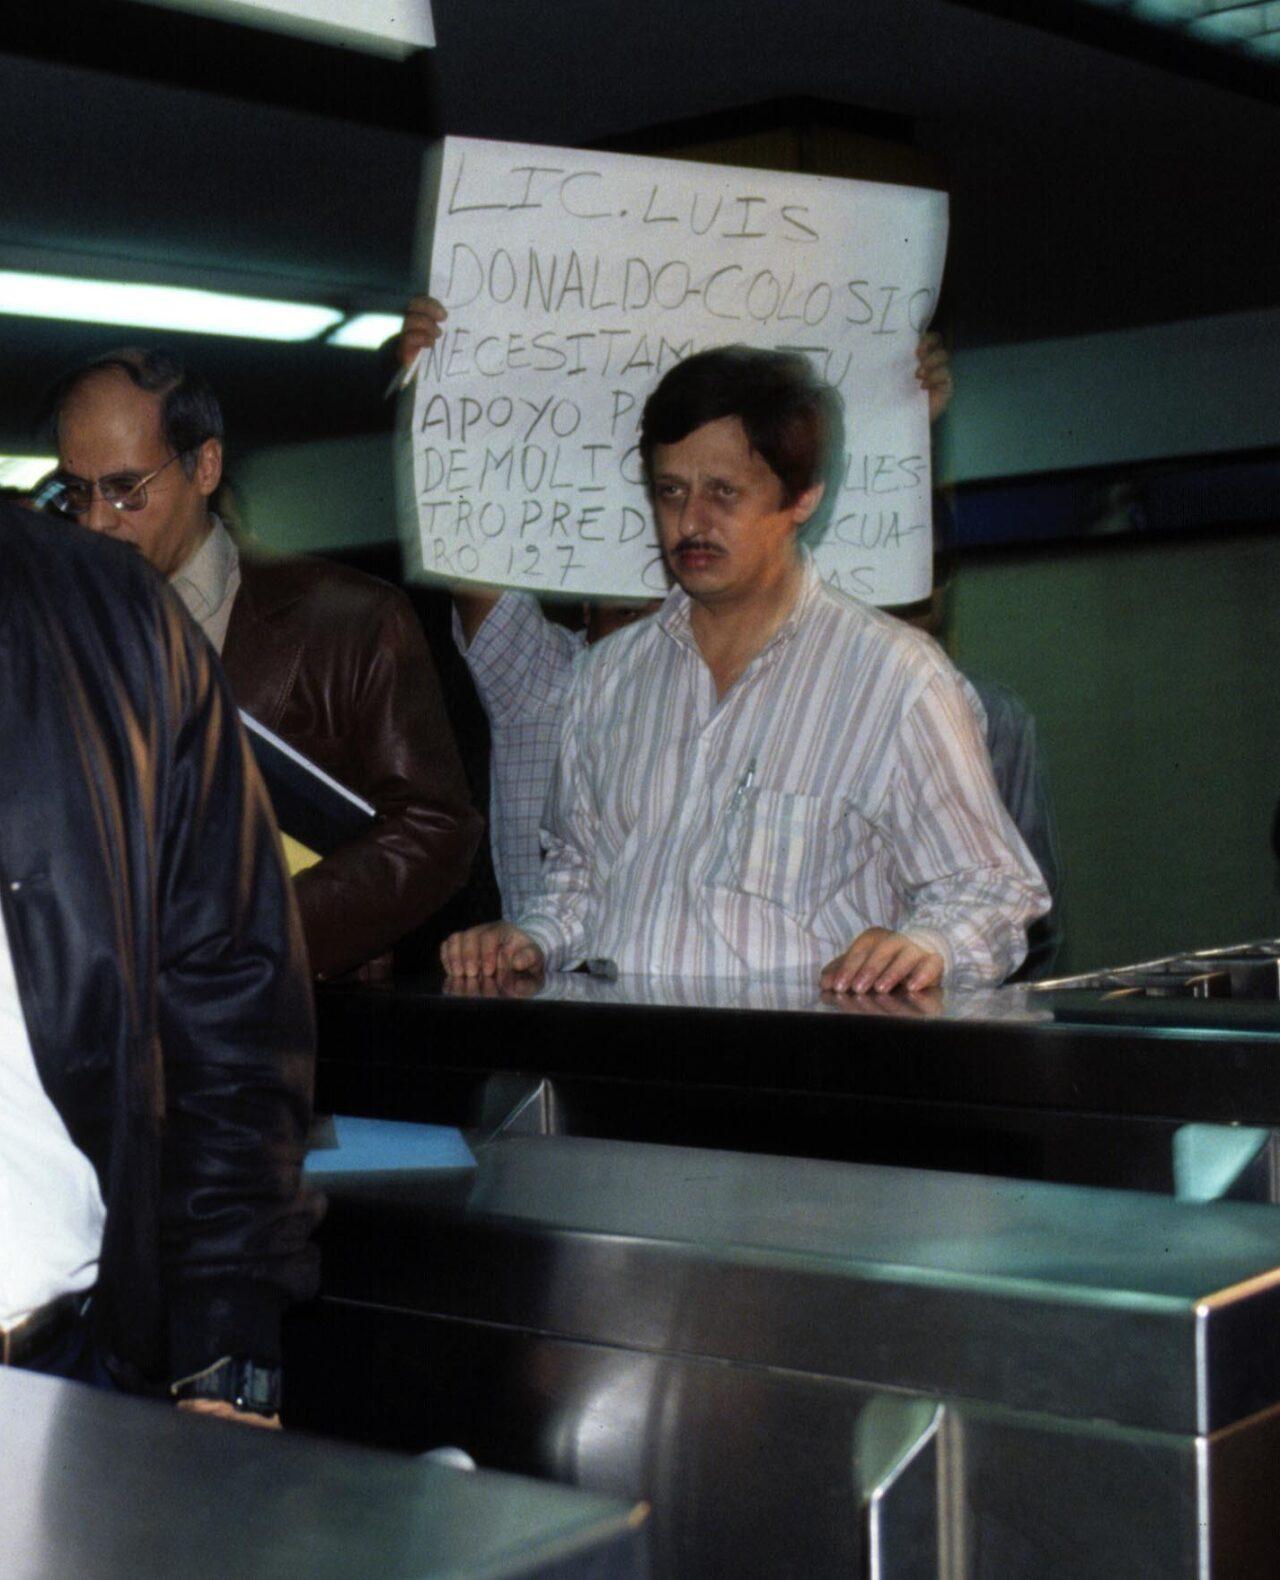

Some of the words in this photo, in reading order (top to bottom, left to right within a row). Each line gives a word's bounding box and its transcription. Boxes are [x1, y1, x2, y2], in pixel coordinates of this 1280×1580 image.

[447, 152, 628, 220] LIC.
[642, 184, 820, 243] LUIS
[423, 328, 694, 383] NECESITAM
[422, 393, 581, 443] APOYO
[423, 445, 647, 493] DEMOLIC
[433, 537, 480, 575] RO
[506, 545, 586, 587] 127
